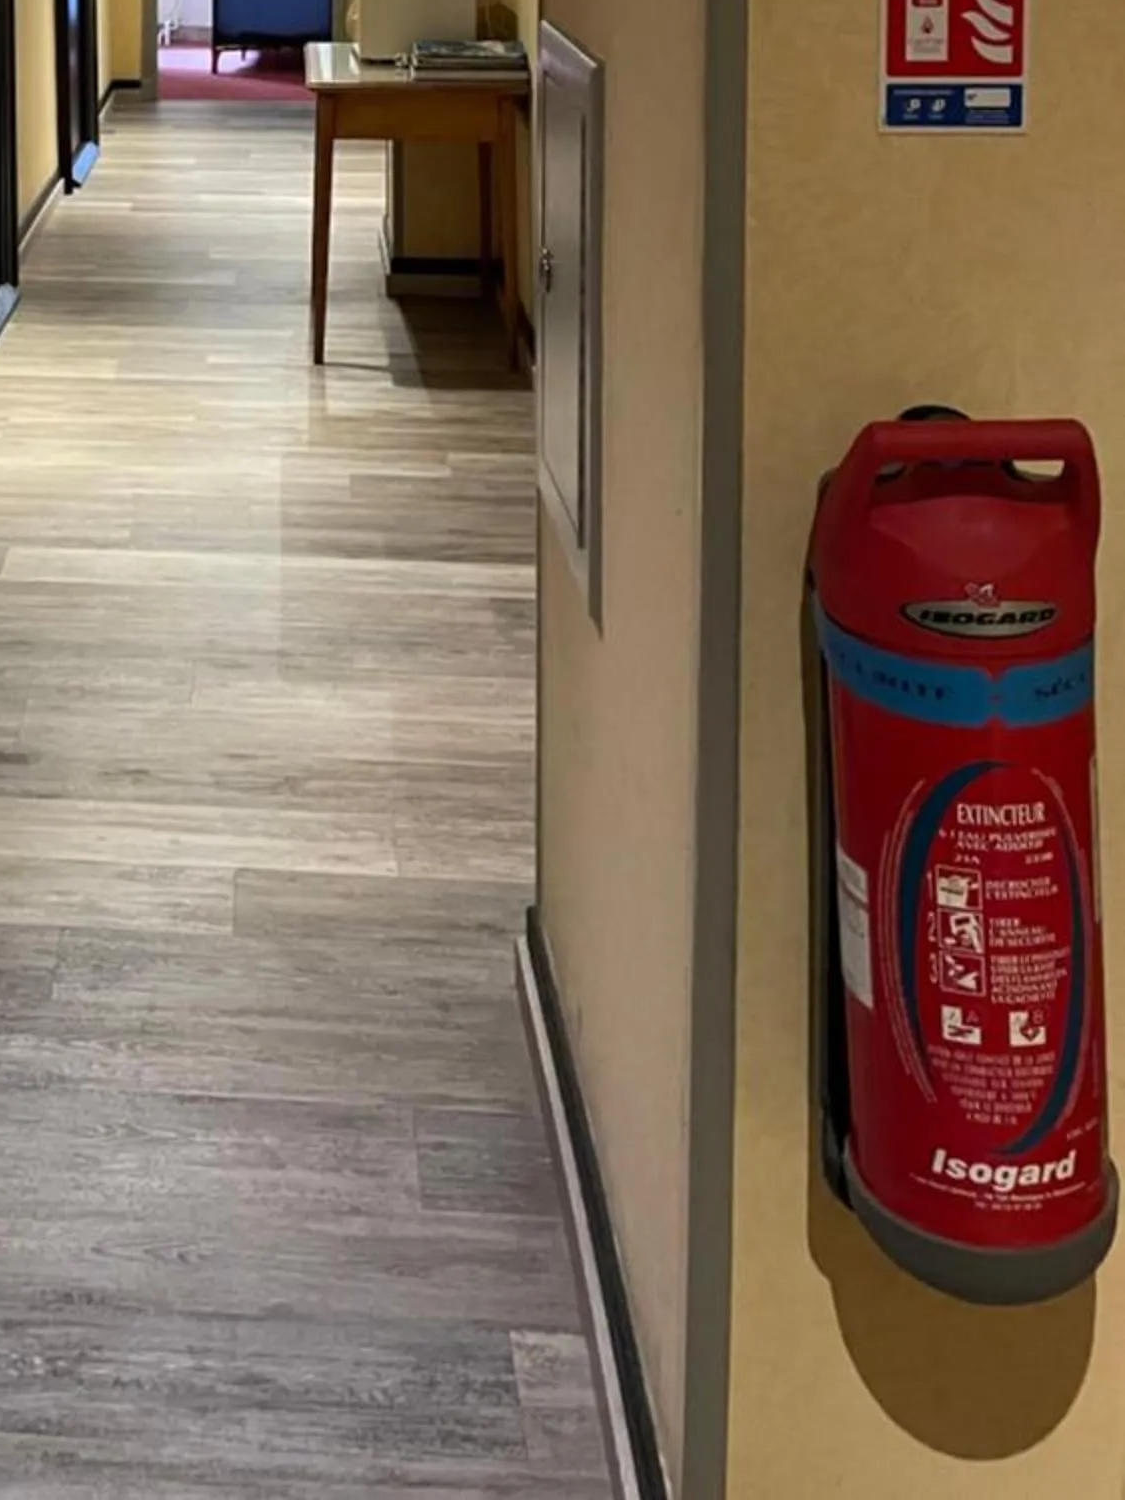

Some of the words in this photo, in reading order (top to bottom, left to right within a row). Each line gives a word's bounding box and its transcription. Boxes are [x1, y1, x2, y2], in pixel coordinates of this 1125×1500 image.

[919, 607, 1056, 626] ISOGARD
[956, 801, 1046, 826] EXTINCTEUR
[931, 1147, 1077, 1192] Isogard
